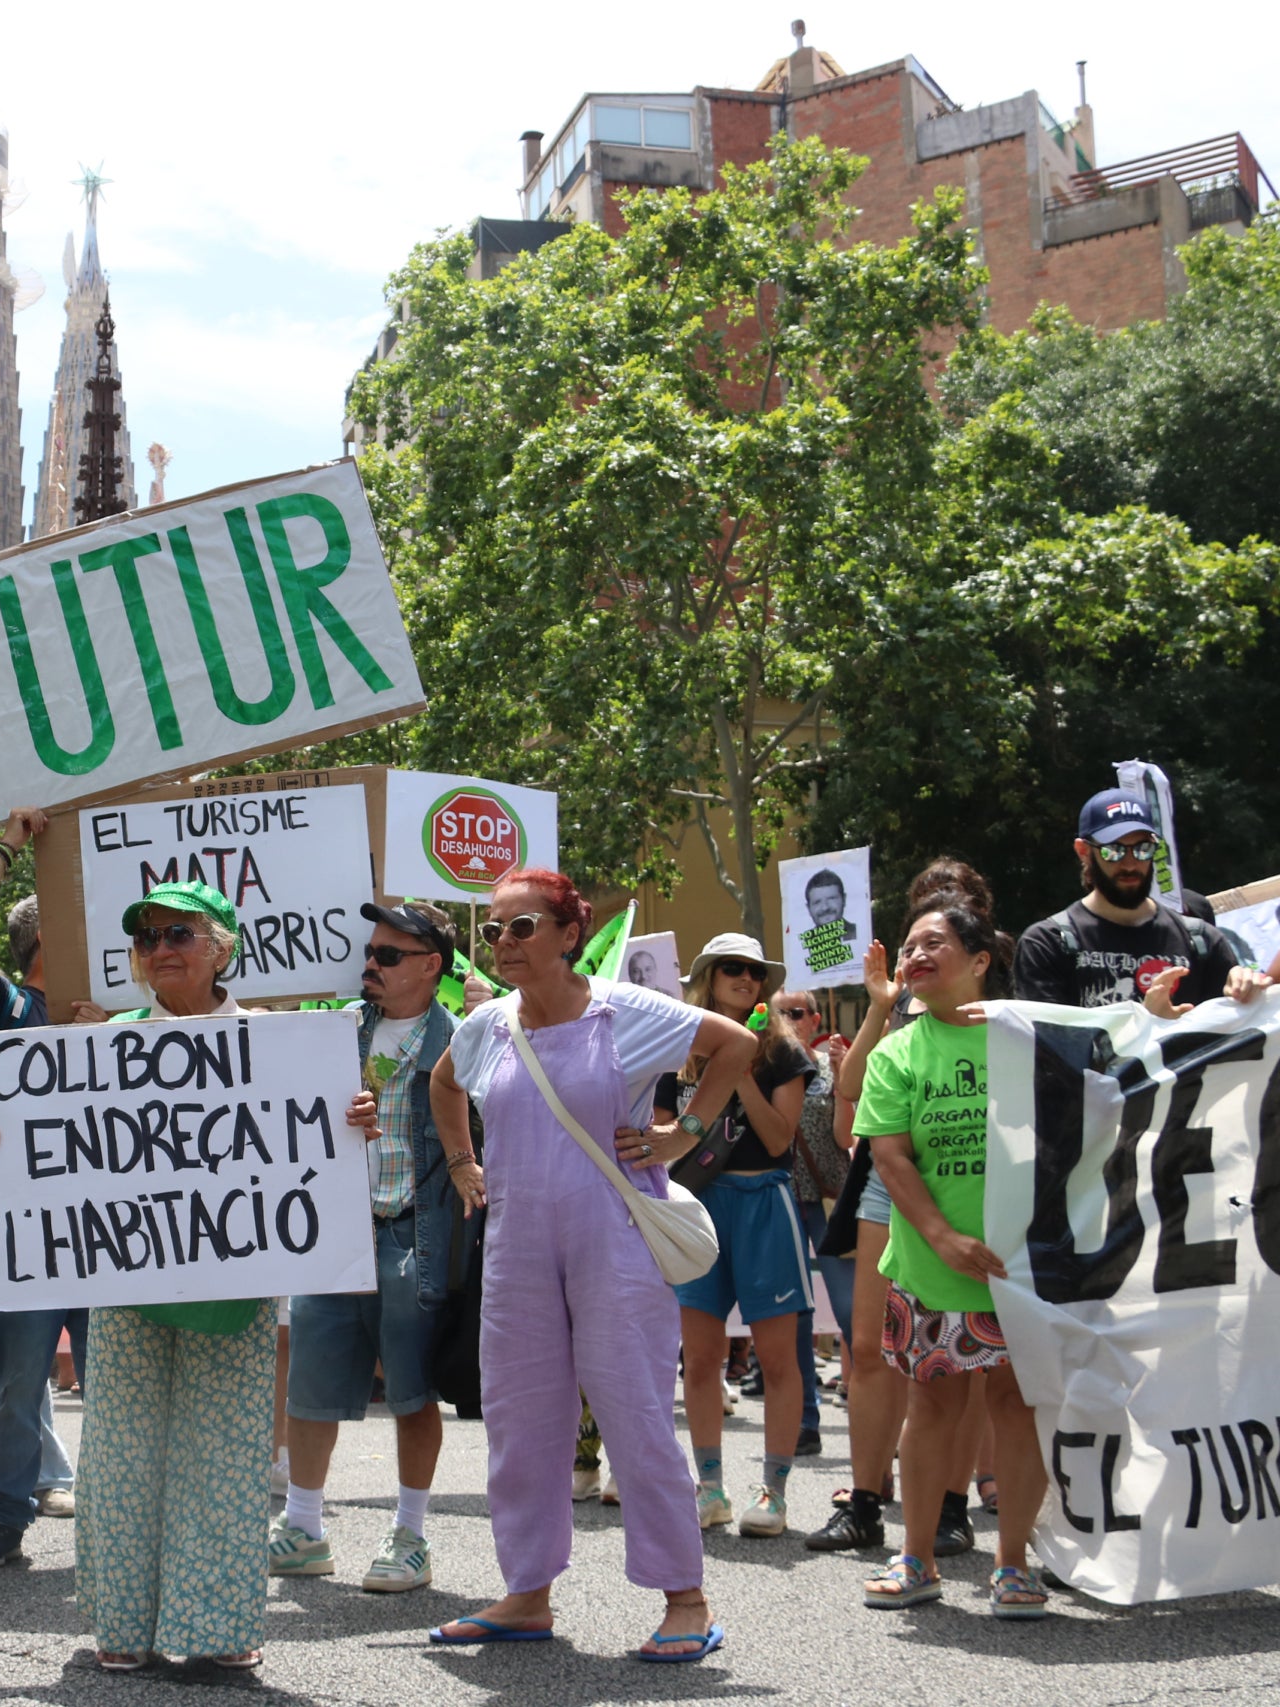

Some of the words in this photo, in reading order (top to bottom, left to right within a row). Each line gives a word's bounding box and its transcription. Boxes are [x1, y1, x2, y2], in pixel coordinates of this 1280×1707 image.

[92, 812, 152, 853] EL
[164, 796, 309, 842] TURISME
[441, 810, 511, 843] STOP
[1106, 801, 1144, 819] FILA
[140, 846, 271, 907] MATA
[441, 840, 512, 861] DESAHUCIOS
[458, 869, 476, 878] PAH
[478, 871, 495, 880] BCN
[24, 1097, 336, 1179] ENDREÇA'M
[5, 1167, 319, 1282] L'HABITACIÓ
[1052, 1429, 1141, 1534] EL
[1171, 1416, 1280, 1529] TUR
